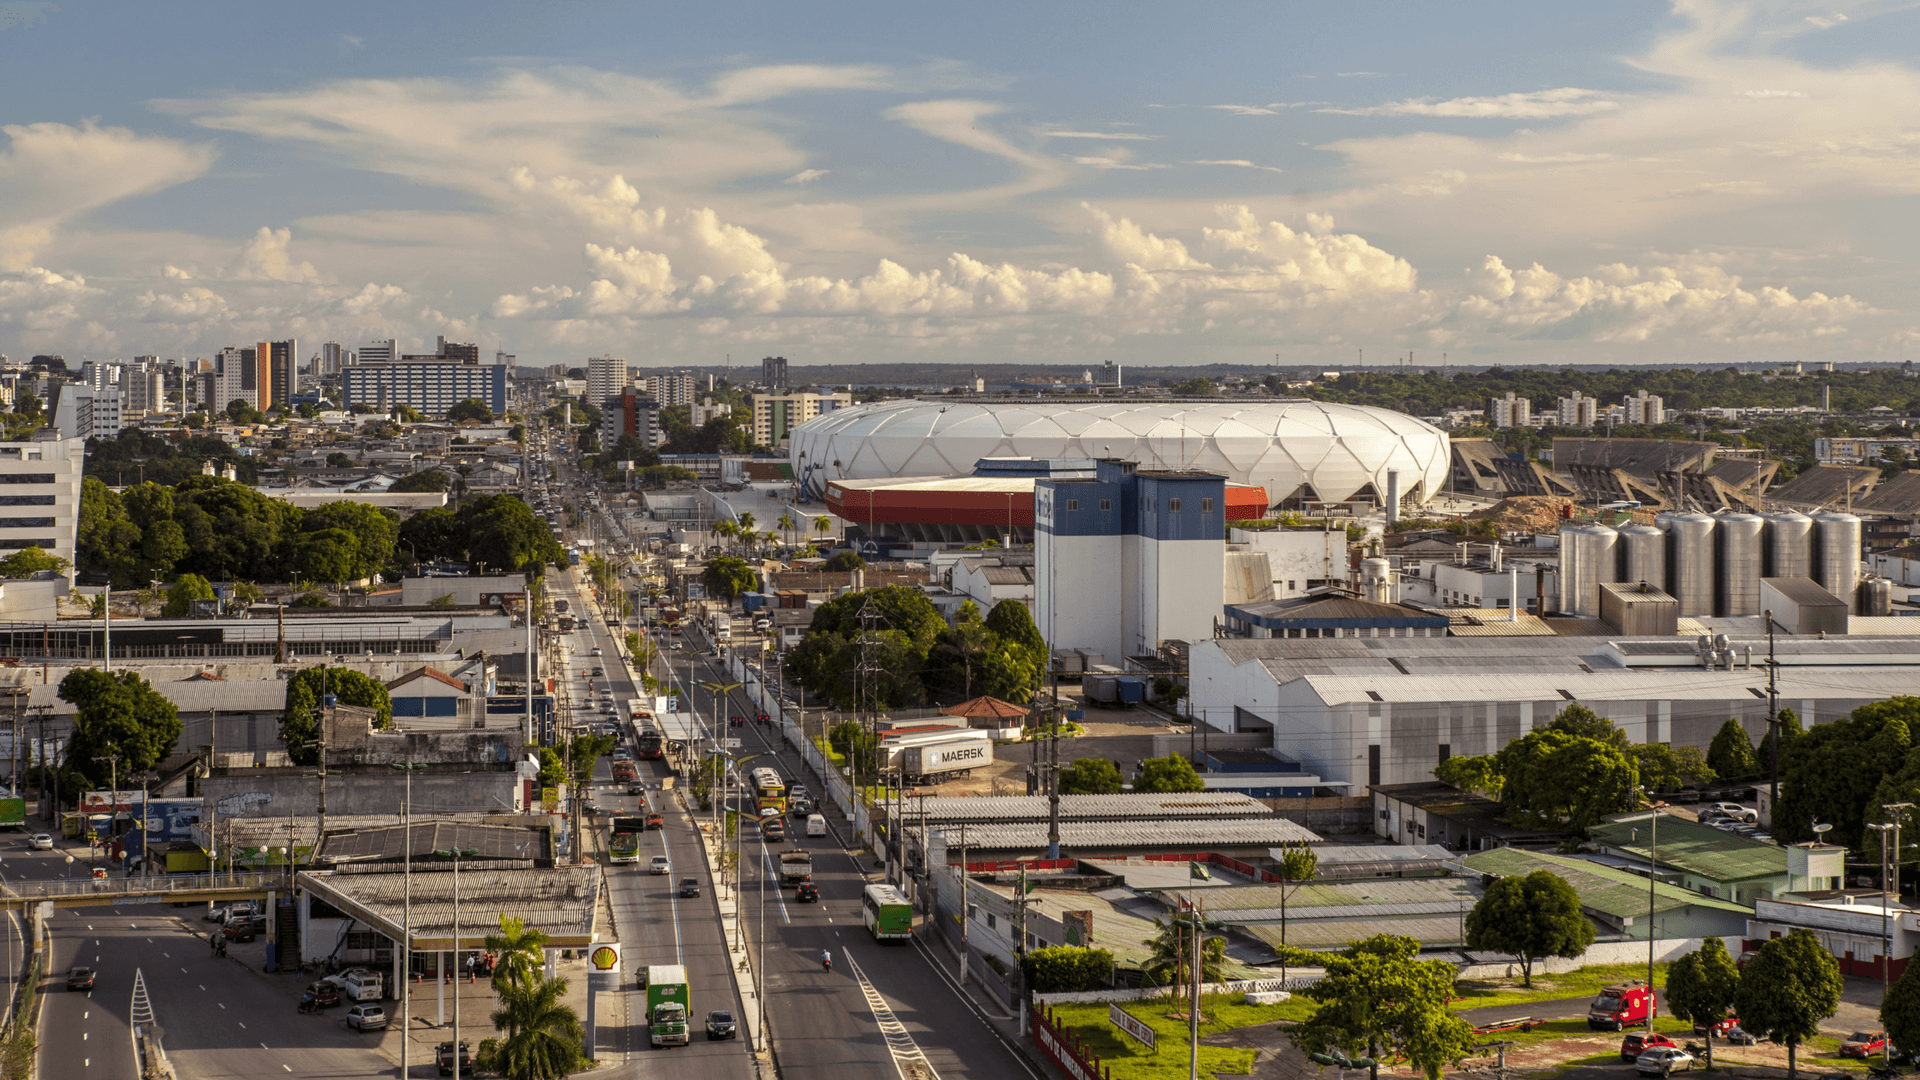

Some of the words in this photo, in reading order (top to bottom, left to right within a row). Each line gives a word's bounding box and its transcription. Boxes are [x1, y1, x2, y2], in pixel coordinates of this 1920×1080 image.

[942, 747, 984, 762] MAERSK
[1040, 1025, 1053, 1052] CORPO
[1053, 1038, 1060, 1060] DE
